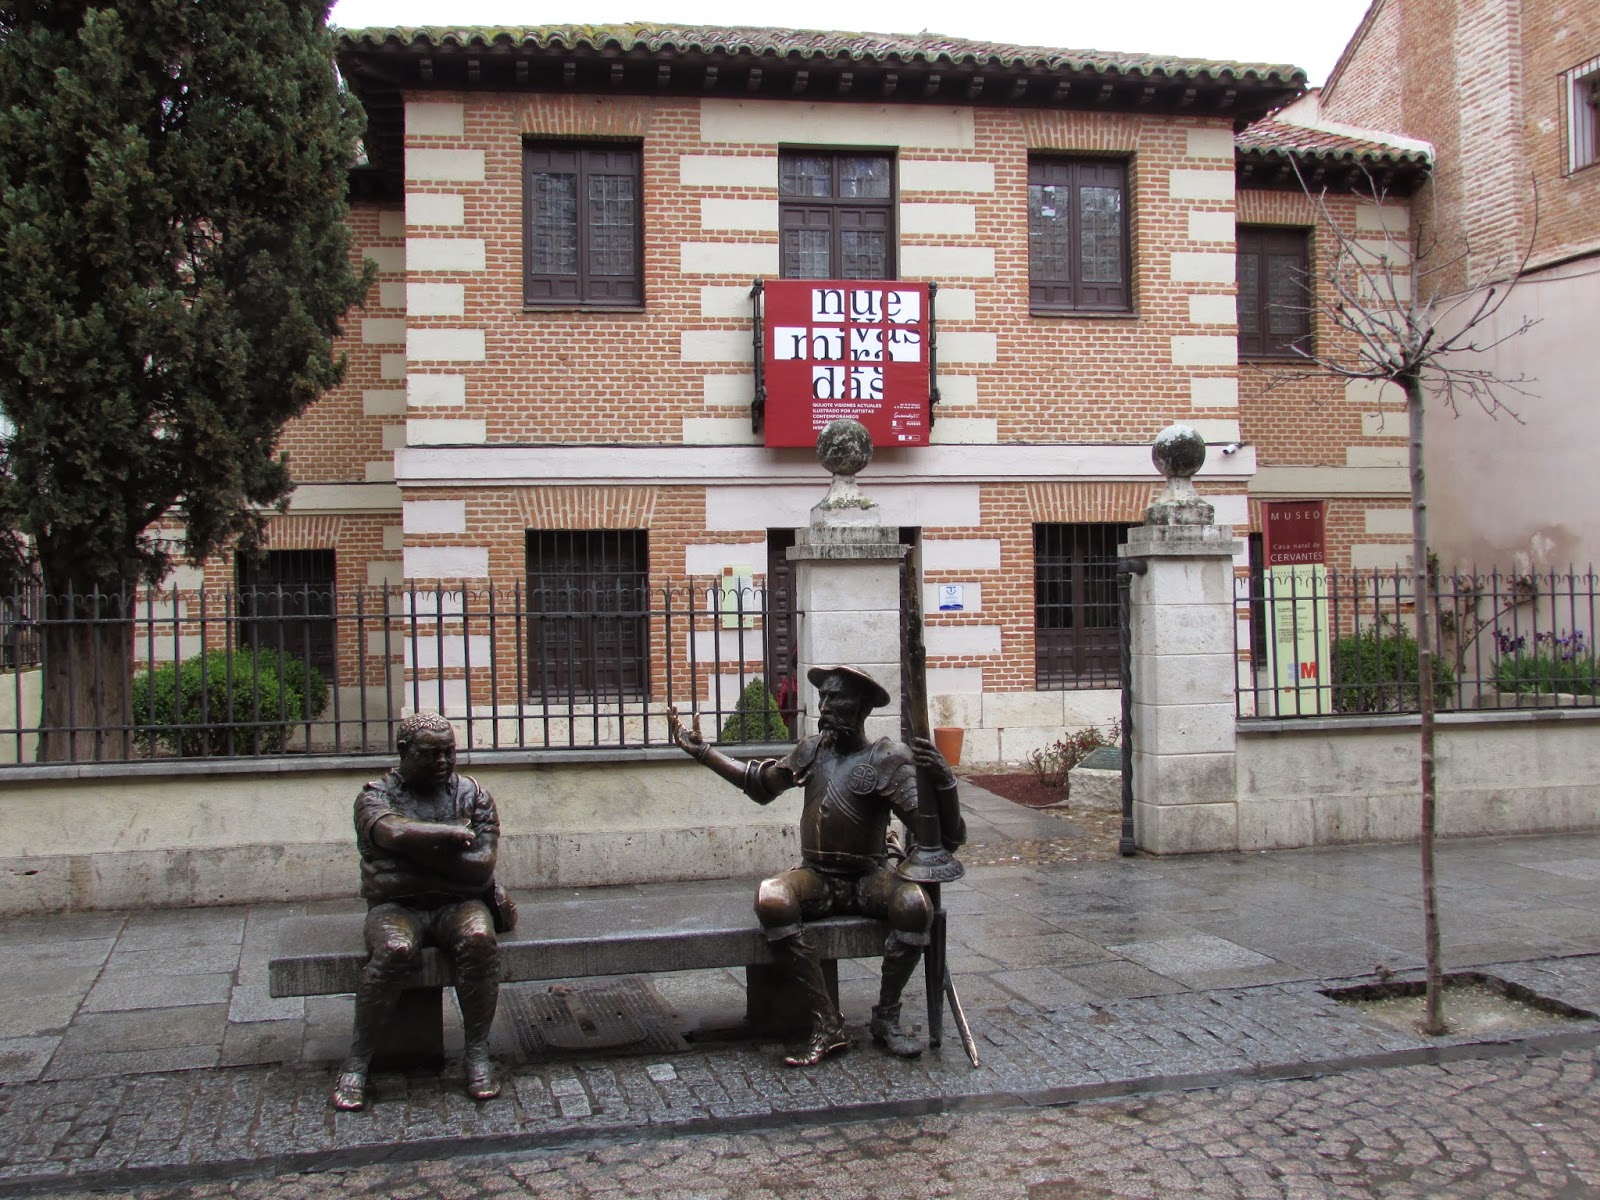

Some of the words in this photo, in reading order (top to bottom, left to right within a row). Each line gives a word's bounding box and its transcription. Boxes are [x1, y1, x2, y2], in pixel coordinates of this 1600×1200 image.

[1270, 511, 1320, 520] MUSEO
[1270, 552, 1323, 563] CERVANTES
[1300, 662, 1318, 679] M
